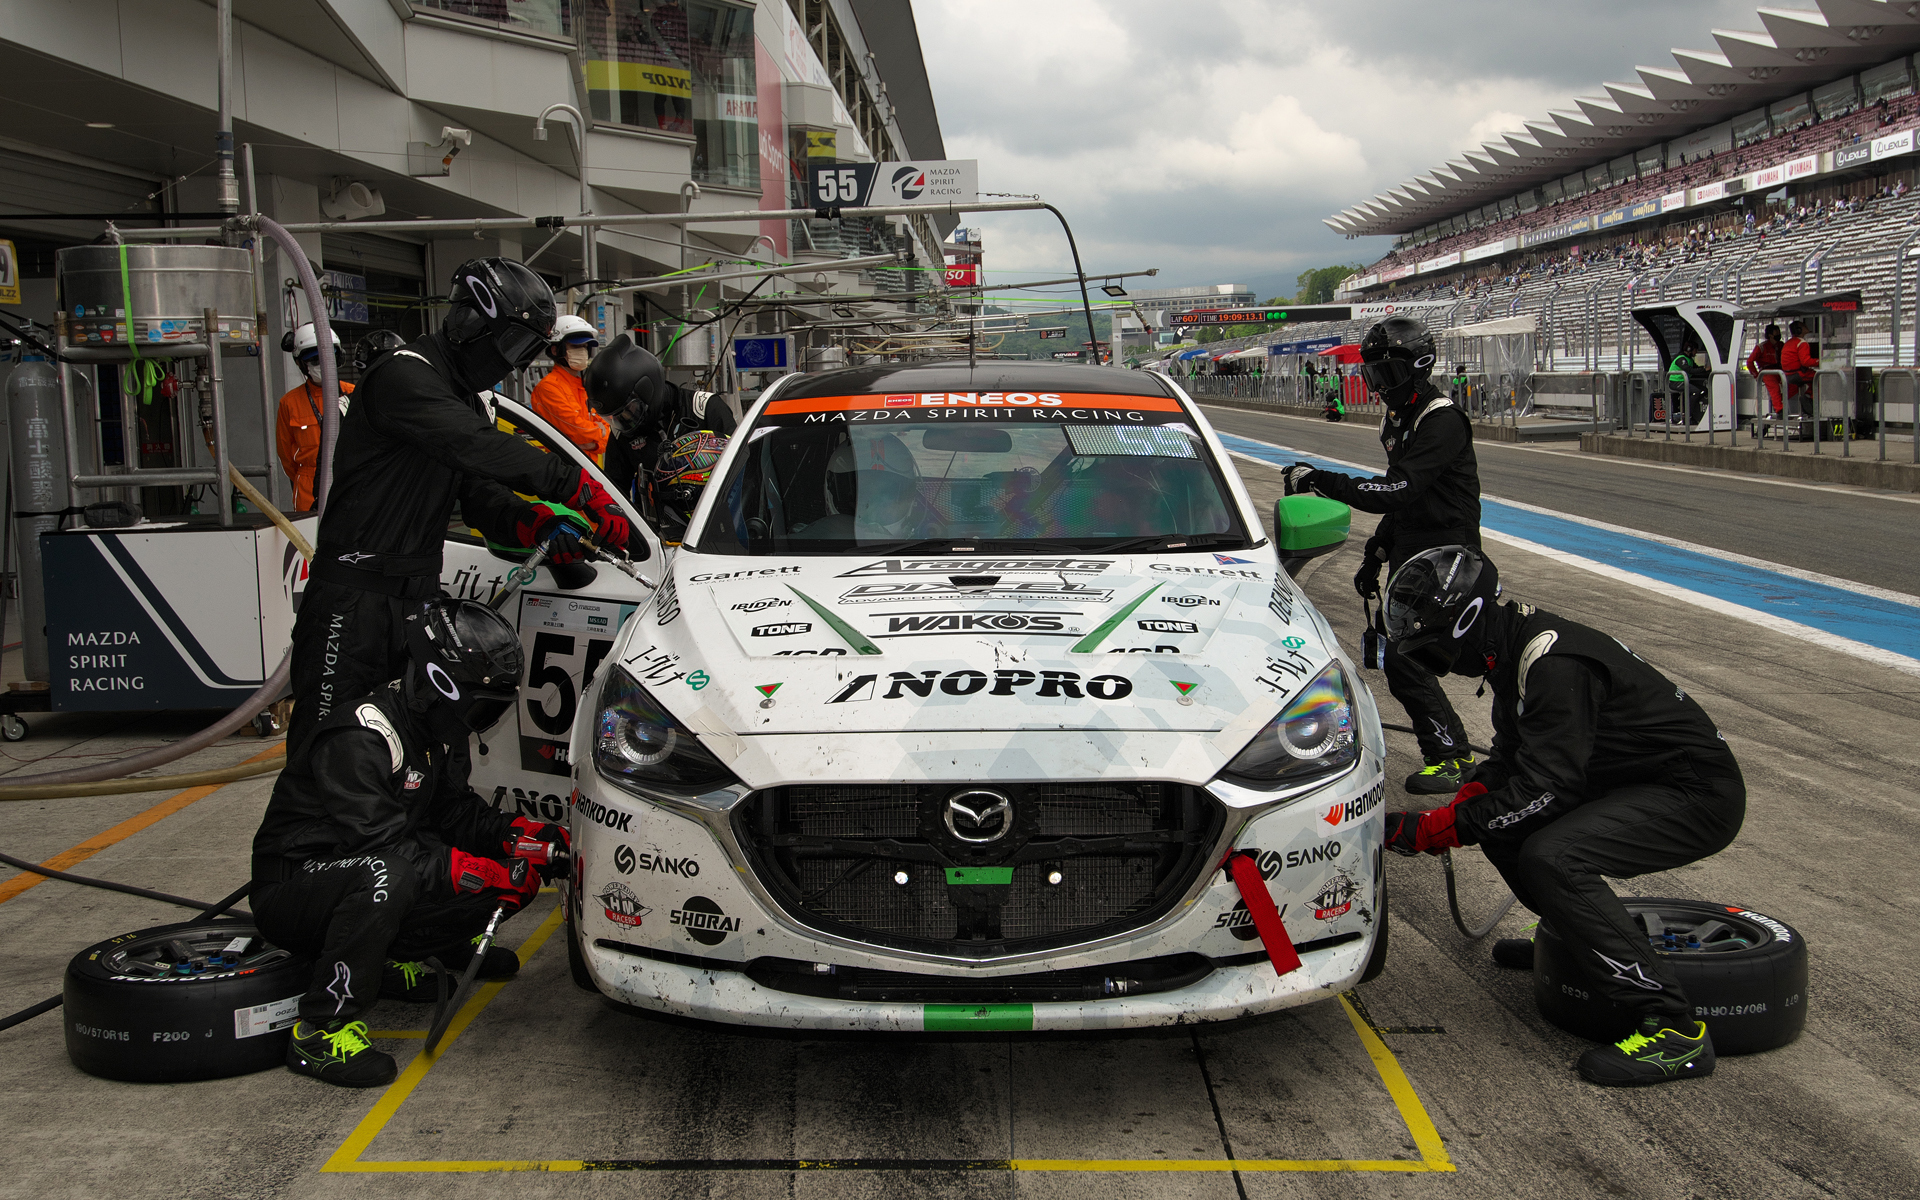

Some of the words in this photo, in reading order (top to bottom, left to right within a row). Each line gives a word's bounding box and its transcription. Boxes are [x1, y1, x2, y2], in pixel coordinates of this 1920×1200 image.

[1883, 138, 1909, 151] LEXUS
[1844, 148, 1868, 162] LEXUS
[930, 168, 960, 176] MAZDA
[1794, 160, 1813, 174] YAMAHA
[1761, 170, 1779, 185] YAMAHA
[818, 169, 858, 202] 55
[930, 188, 962, 196] RACING
[1218, 312, 1263, 321] 19:09:13.1
[921, 393, 1063, 406] ENEOS
[804, 409, 911, 423] MAZDA
[927, 408, 1015, 418] SPIRIT
[1032, 408, 1145, 421] RACING
[689, 565, 803, 582] Garrett
[833, 559, 1116, 578] Aragosta
[1148, 563, 1263, 580] Garrett
[688, 576, 753, 587] ADVANCING
[758, 572, 801, 581] MOTION
[731, 598, 793, 612] IBIDEN
[1161, 595, 1221, 607] IBIDEN
[756, 623, 808, 636] TONE
[889, 613, 1064, 632] WAKO'S
[1141, 622, 1196, 632] TONE
[68, 631, 141, 646] MAZDA
[322, 613, 344, 676] MAZDA
[69, 654, 127, 669] SPIRIT
[70, 676, 144, 691] RACING
[824, 669, 1133, 704] ANOPRO
[318, 682, 334, 721] SPIR
[1286, 840, 1341, 869] SANKO
[640, 853, 700, 878] SANKO
[609, 896, 635, 914] HM
[1321, 906, 1346, 918] RACERS
[612, 913, 637, 926] RACERS
[669, 909, 741, 932] SHORAI
[153, 1031, 190, 1042] F200
